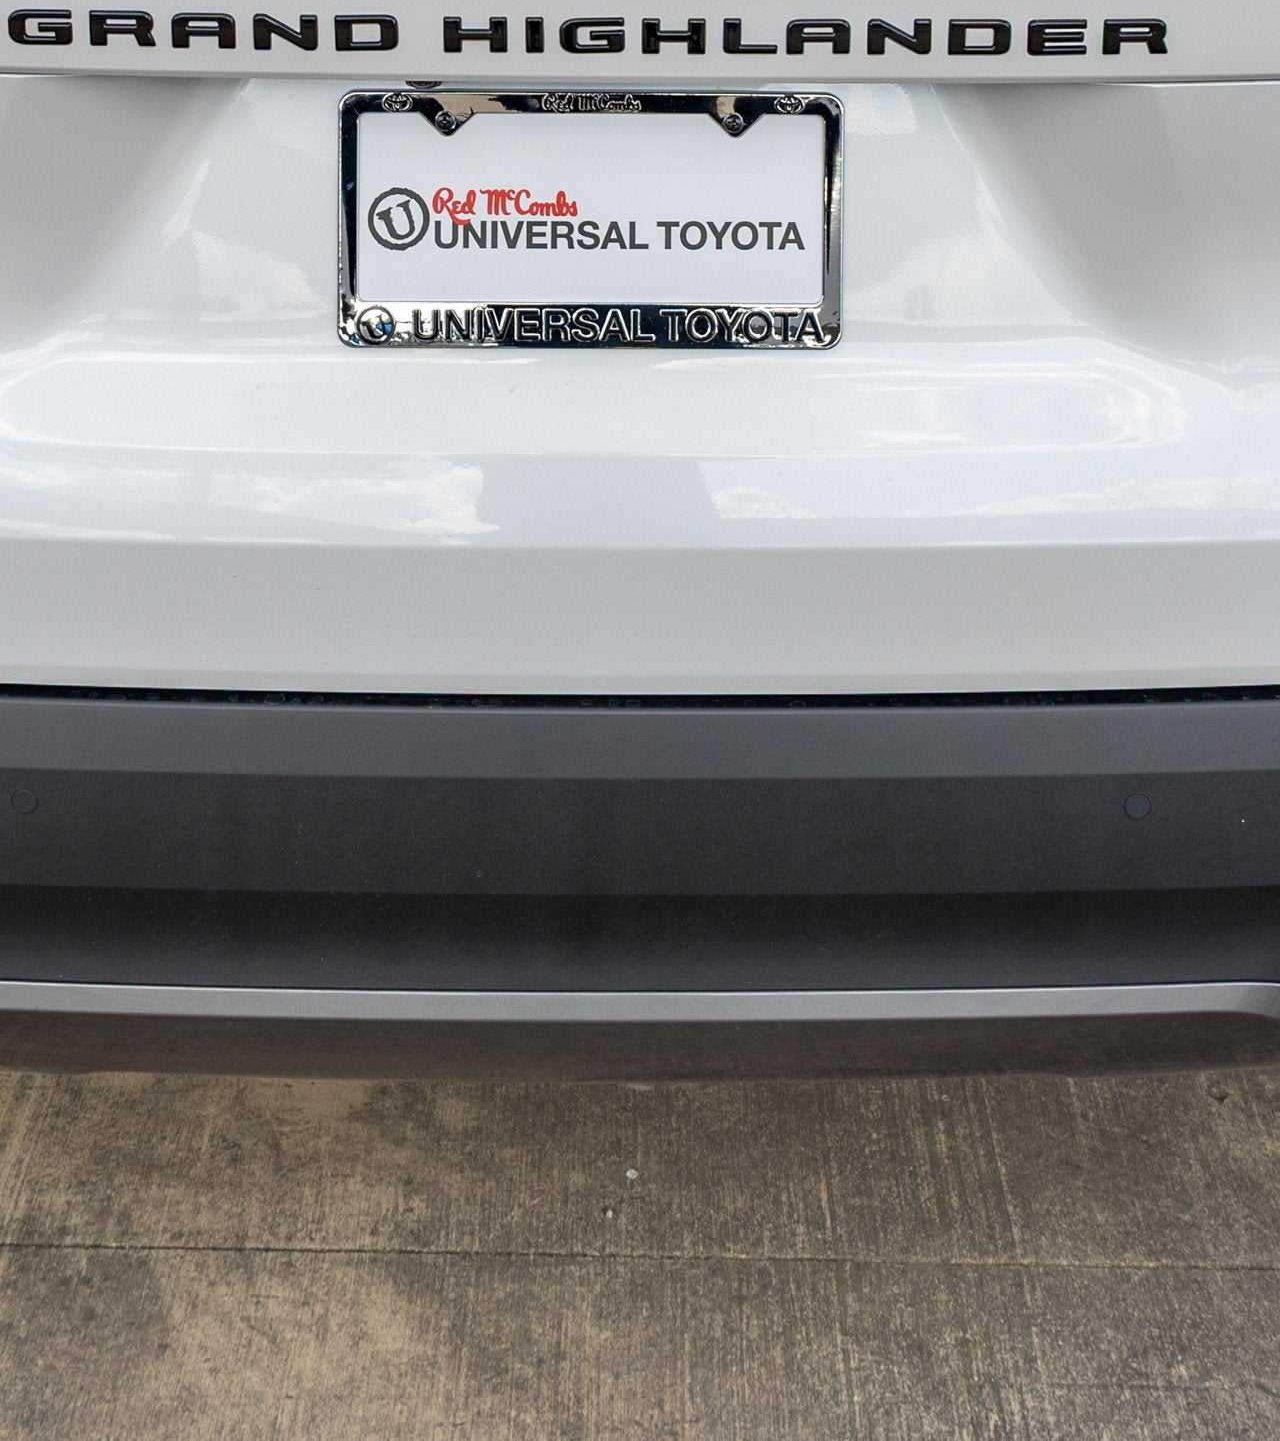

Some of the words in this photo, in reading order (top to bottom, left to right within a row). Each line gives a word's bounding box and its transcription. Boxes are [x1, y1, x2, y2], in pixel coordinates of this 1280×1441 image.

[6, 7, 401, 53] GRAND
[442, 14, 1169, 56] HIGHLANDER
[432, 187, 477, 225] Red
[480, 188, 578, 217] McCombs
[434, 220, 650, 251] UNIVERSAL
[657, 220, 806, 251] TOYOTA
[410, 307, 655, 344] UNIVERSAL
[659, 307, 826, 344] TOYOTA
